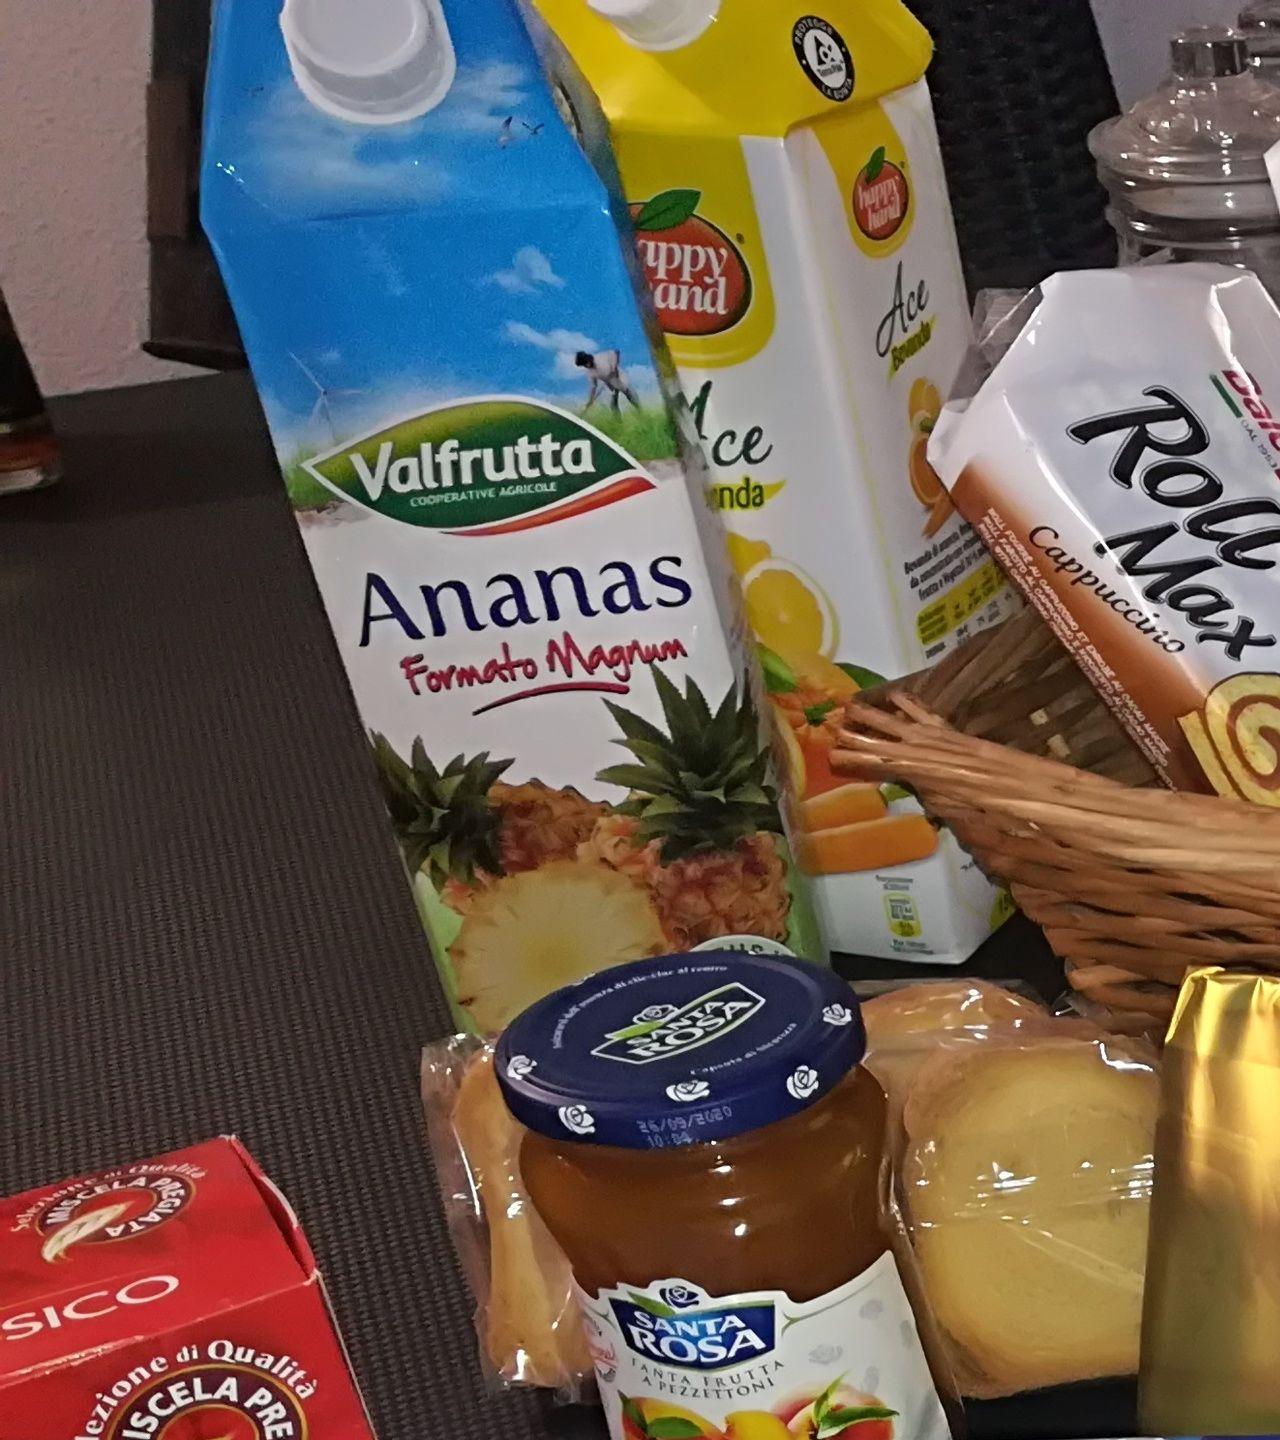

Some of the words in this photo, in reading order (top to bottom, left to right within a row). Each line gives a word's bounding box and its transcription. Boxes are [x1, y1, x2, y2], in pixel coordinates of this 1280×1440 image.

[638, 239, 728, 283] appy
[653, 277, 729, 315] and
[876, 261, 928, 358] Ace
[350, 433, 597, 500] Valfrutta
[409, 485, 495, 508] COOPERATIVE
[500, 480, 558, 499] AGRICOLE
[359, 553, 693, 647] Ananas
[1029, 526, 1185, 653] Cappuccino
[1099, 520, 1278, 664] Max
[400, 648, 539, 697] Formato
[544, 631, 689, 684] Magnum
[626, 1000, 724, 1046] SANTA
[628, 1000, 753, 1056] ROSA
[46, 1176, 149, 1224] MISCELA
[105, 1177, 185, 1238] PREGIATA
[2, 1275, 180, 1340] SICO
[633, 1311, 747, 1337] SANTA
[176, 1345, 199, 1364] di
[208, 1339, 318, 1399] Qualità
[627, 1323, 767, 1362] ROSA
[632, 1358, 691, 1385] TANTA
[704, 1361, 784, 1387] FRUTTA
[643, 1377, 652, 1386] A
[660, 1379, 774, 1400] PEZZETTONI
